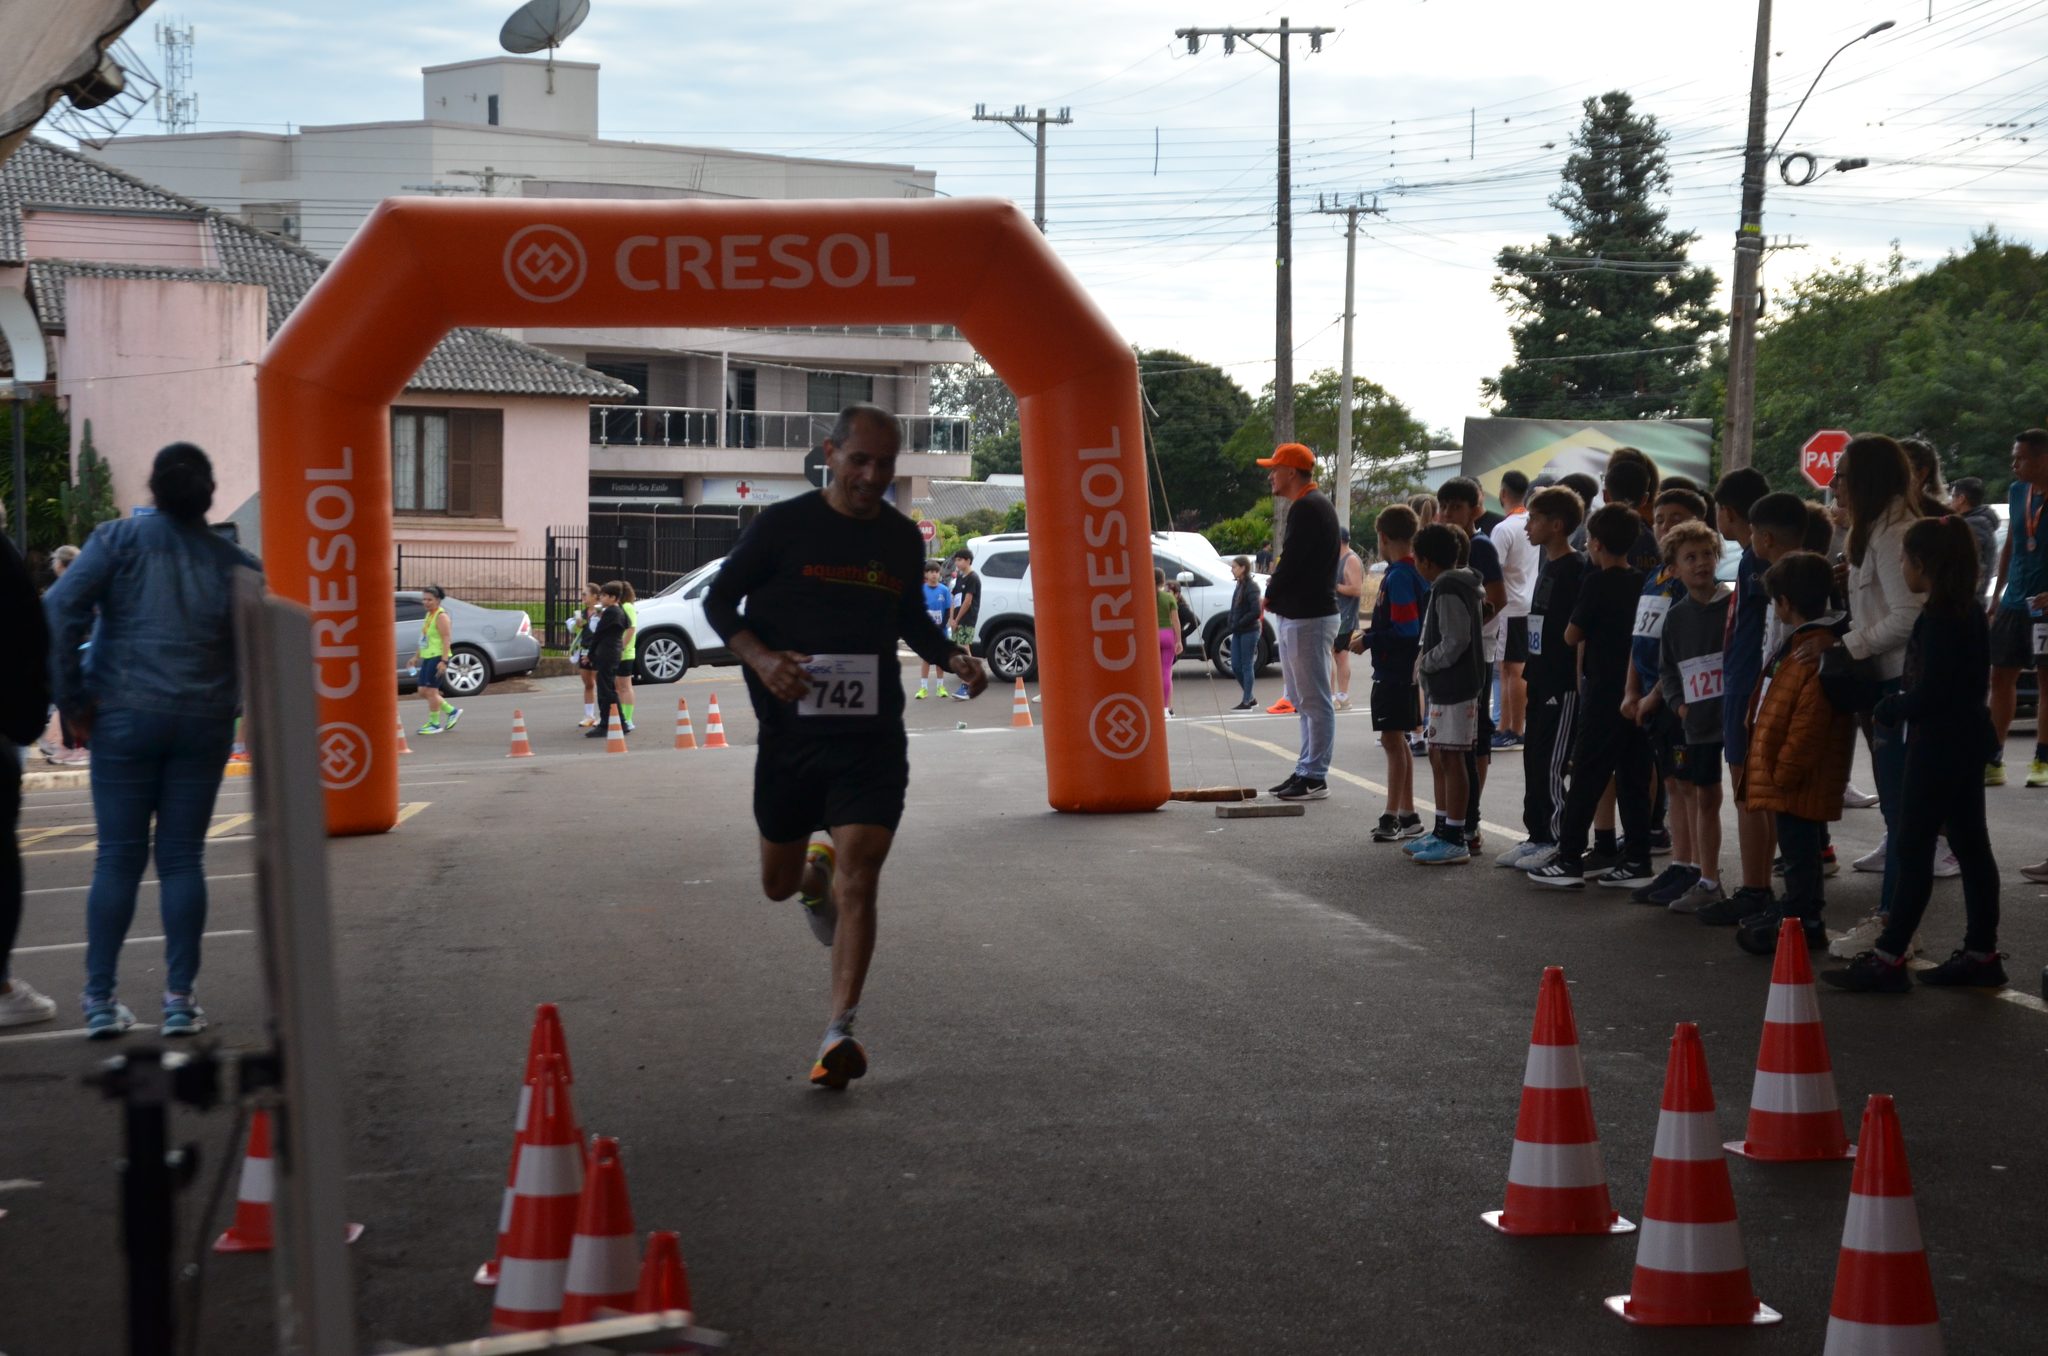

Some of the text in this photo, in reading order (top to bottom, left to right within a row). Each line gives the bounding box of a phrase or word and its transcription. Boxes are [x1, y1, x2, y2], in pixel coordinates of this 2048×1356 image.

[615, 232, 916, 292] CRESOL
[305, 446, 361, 700] CRESOL
[1078, 425, 1137, 672] CRESOL
[812, 680, 865, 709] 742
[1690, 668, 1724, 698] 127
